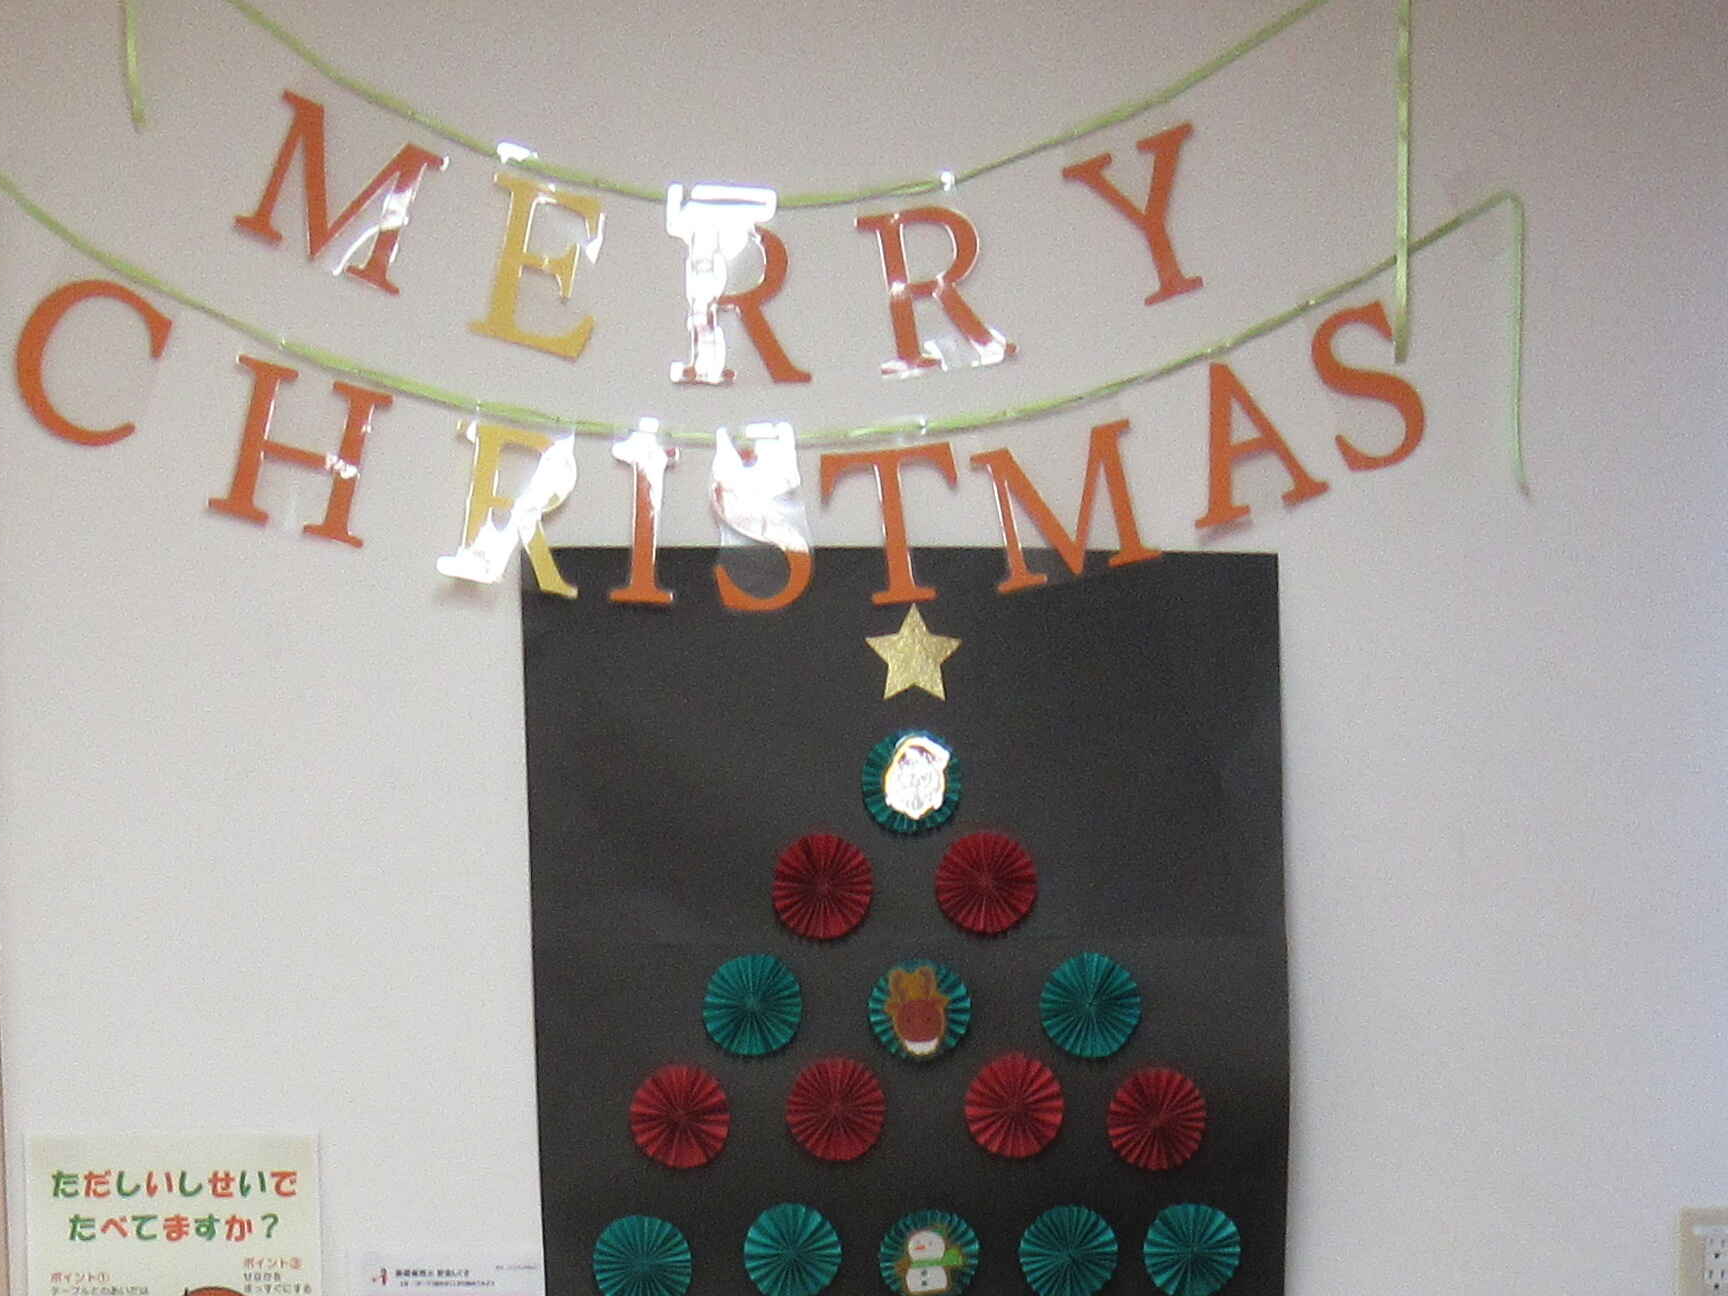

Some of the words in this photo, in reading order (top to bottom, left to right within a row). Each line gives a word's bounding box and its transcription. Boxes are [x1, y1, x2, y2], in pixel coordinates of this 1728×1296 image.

[234, 90, 1204, 386] MERRY
[15, 278, 1428, 613] CHRISTMAS
[52, 1169, 298, 1198] ただしいしせいで
[68, 1213, 280, 1242] たべてますか？
